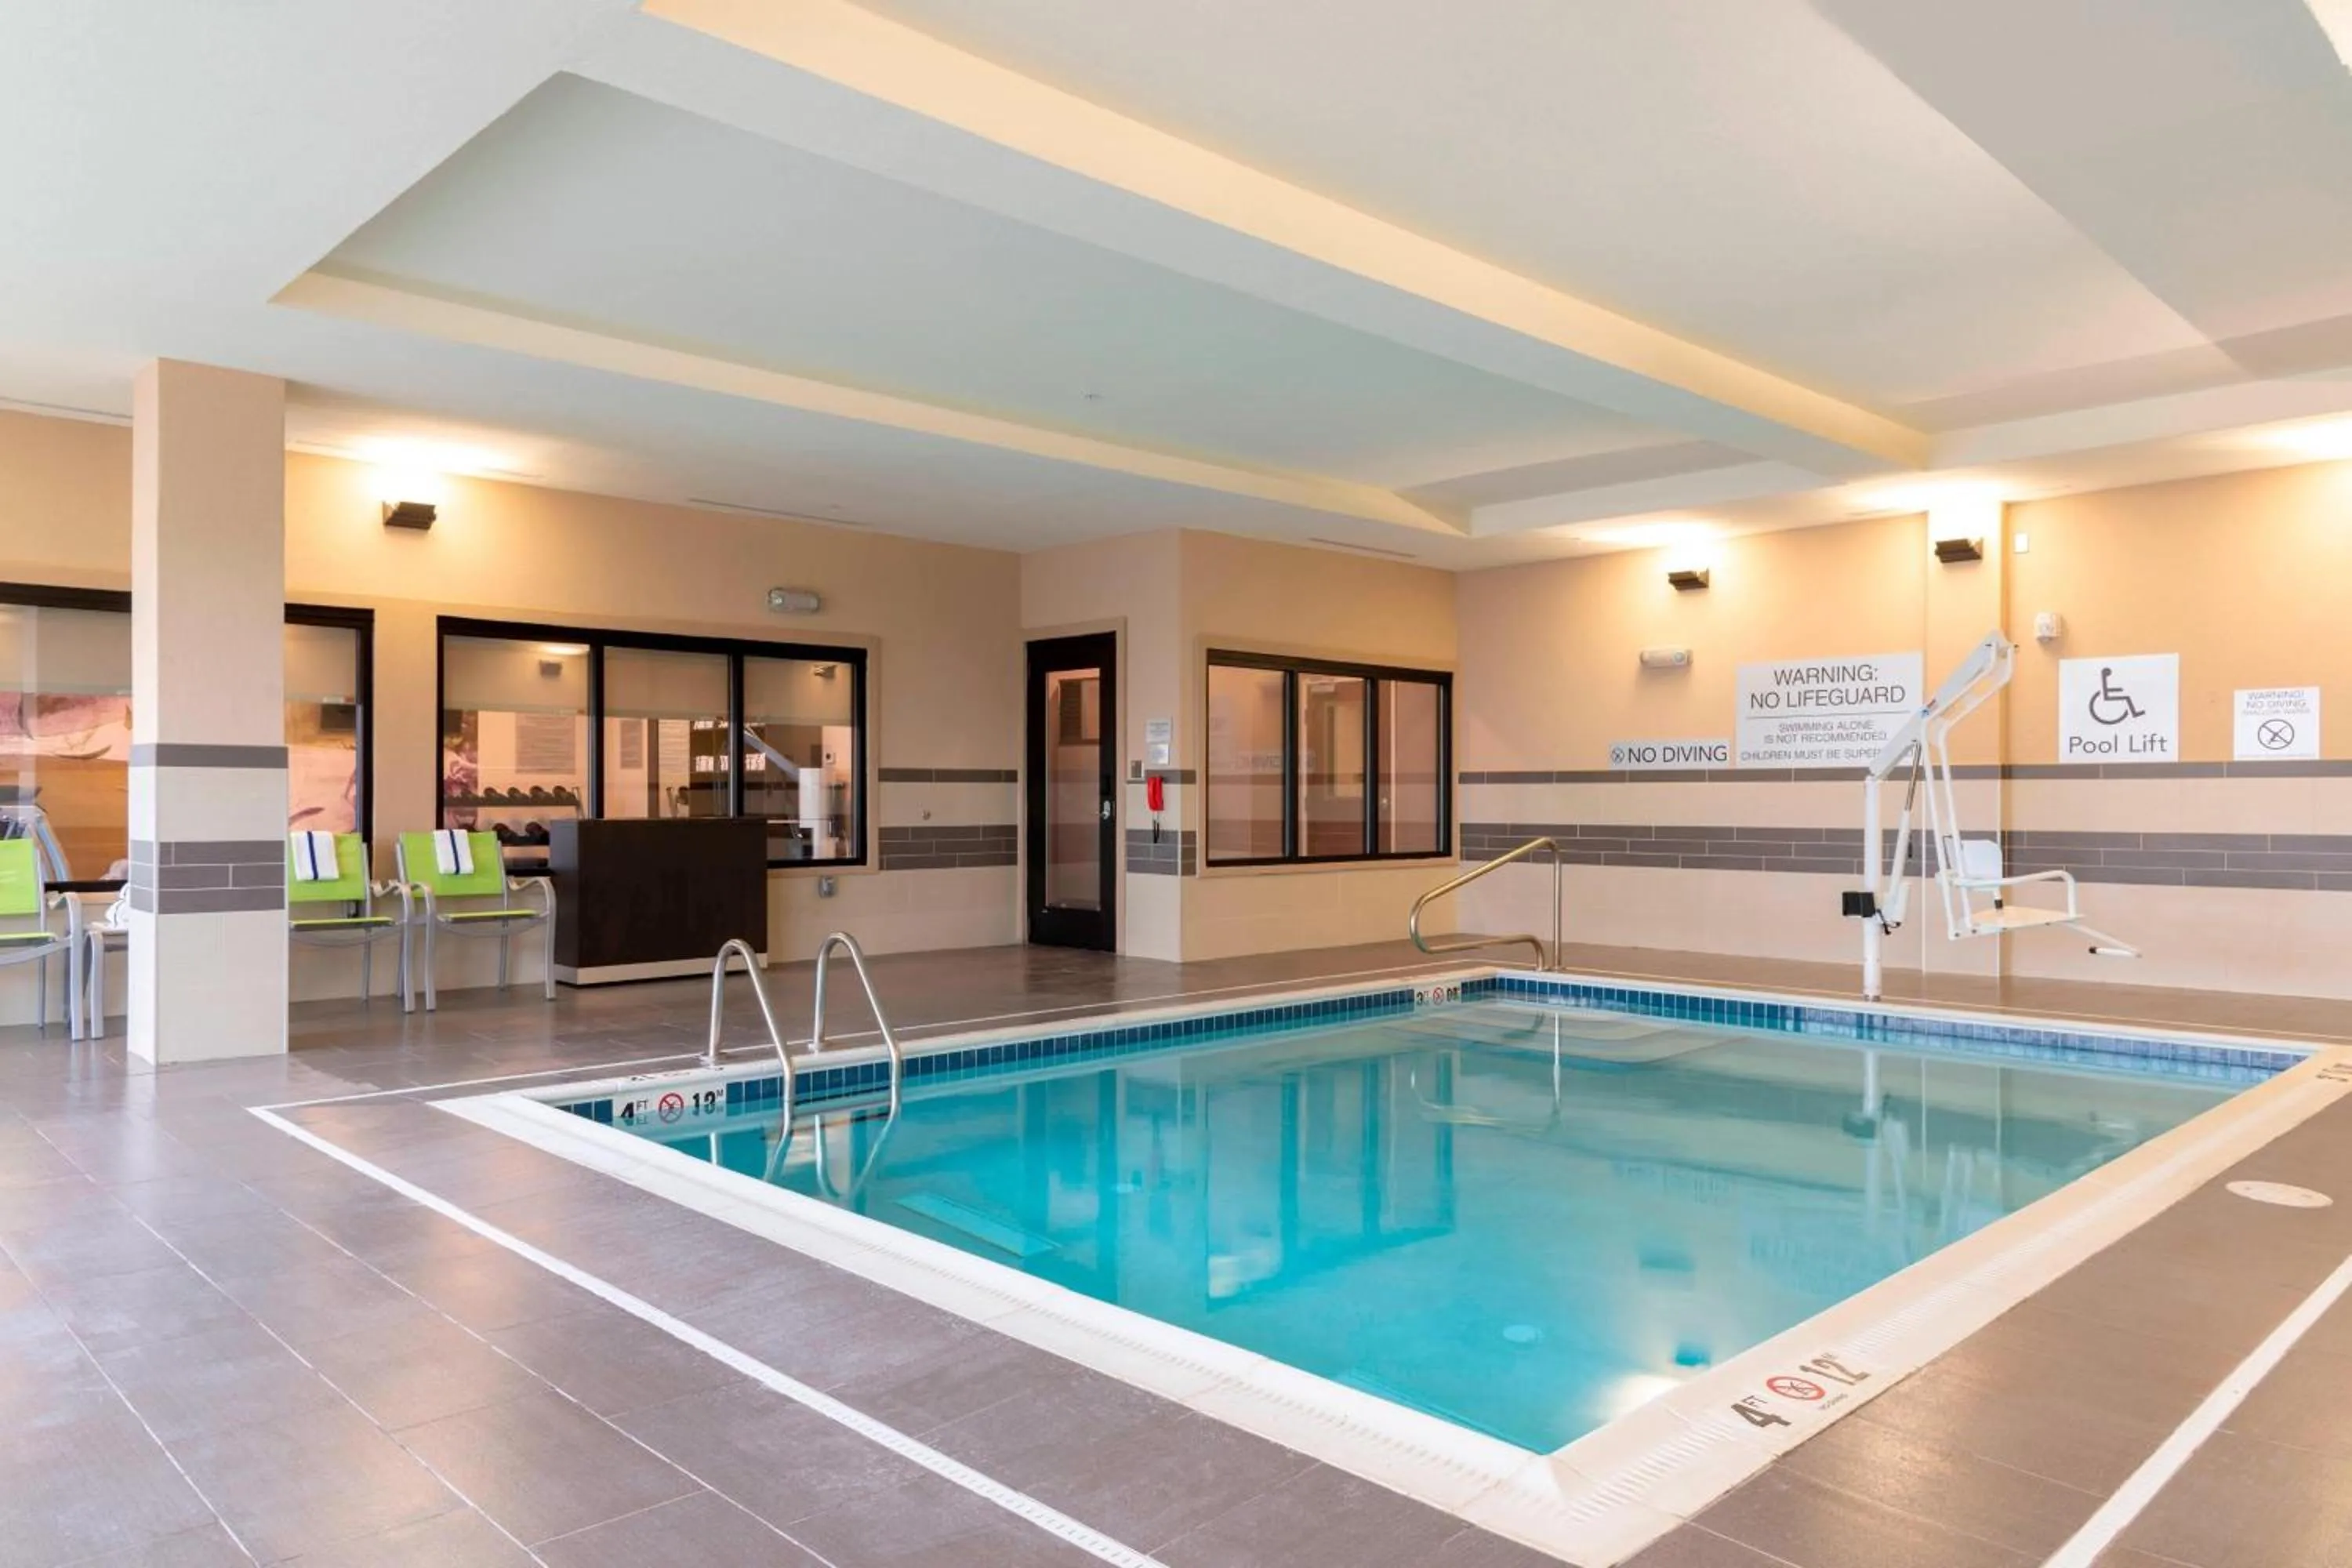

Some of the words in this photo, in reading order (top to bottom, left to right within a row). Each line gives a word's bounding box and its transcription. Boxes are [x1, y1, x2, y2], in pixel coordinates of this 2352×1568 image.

[1774, 664, 1878, 686] WARNING:
[1751, 692, 1780, 710] NO
[1787, 685, 1906, 708] LIFEGUARD
[1779, 720, 1833, 733] SWIMMING
[1837, 720, 1874, 730] ALONE
[1764, 734, 1773, 744] IS
[1777, 733, 1797, 744] NOT
[2069, 735, 2118, 753] Pool
[2129, 733, 2168, 753] Lift
[1628, 746, 1657, 763] NO
[1663, 746, 1728, 763] DIVING
[1741, 750, 1791, 761] CHILDREN
[1795, 749, 1824, 760] MUST
[1827, 748, 1842, 759] BE
[1730, 1403, 1792, 1428] 4
[1798, 1358, 1871, 1386] 12
